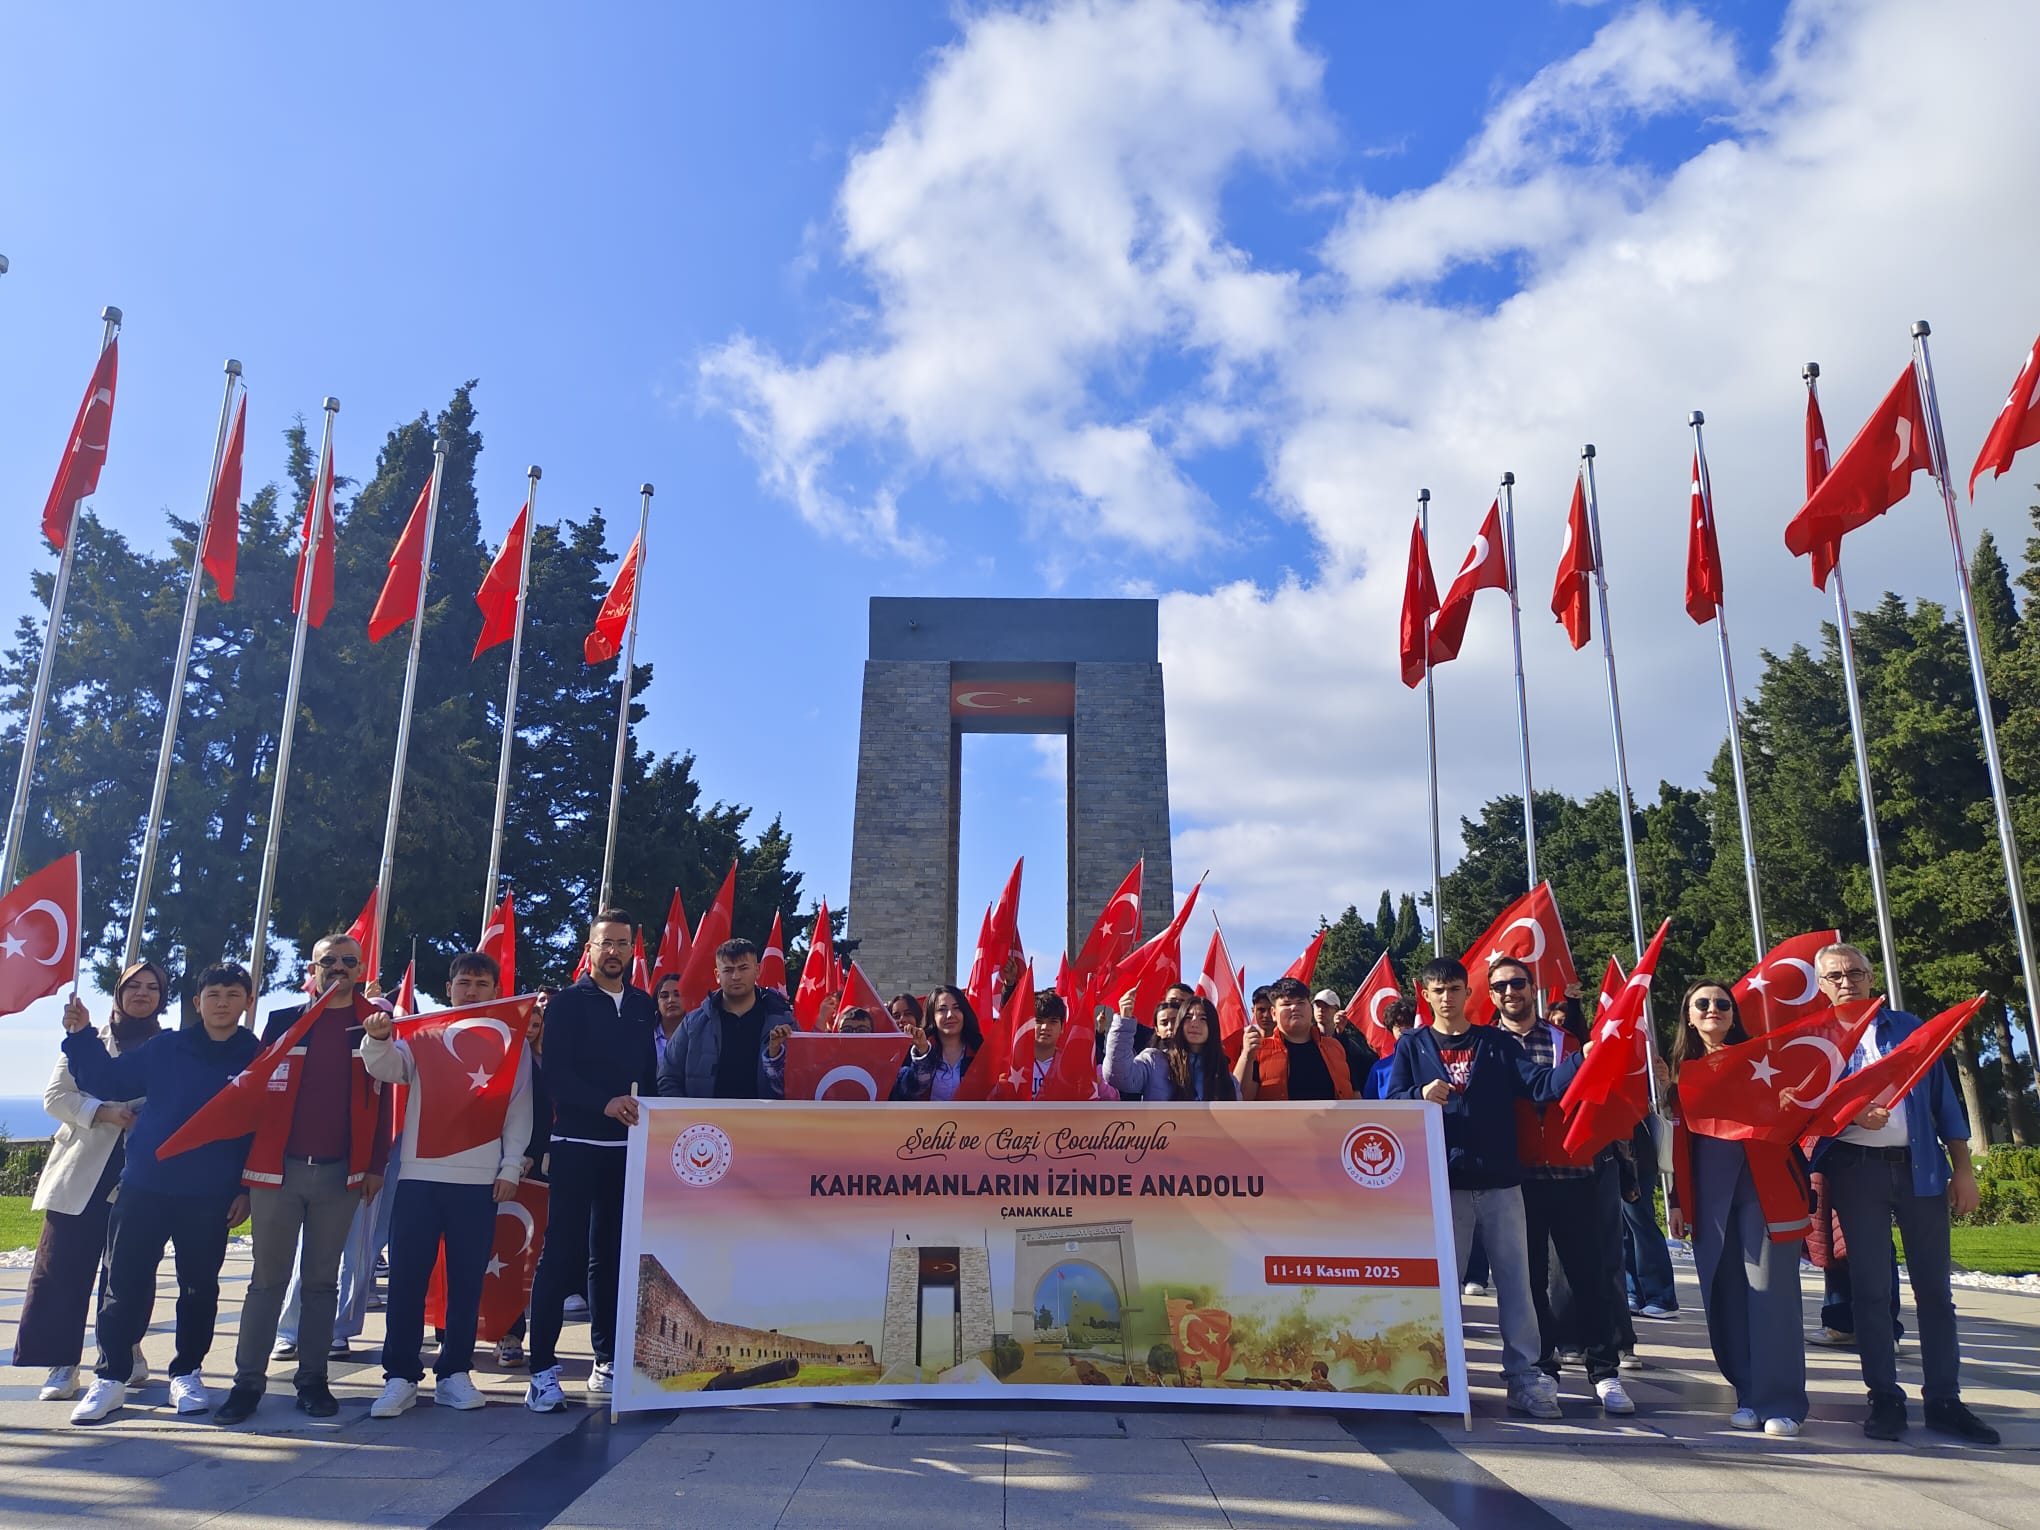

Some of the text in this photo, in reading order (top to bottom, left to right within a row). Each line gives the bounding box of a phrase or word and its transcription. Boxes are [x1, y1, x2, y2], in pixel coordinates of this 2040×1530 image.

[896, 1120, 1176, 1164] Şehit ve Gazi Çocuklarıyla
[810, 1168, 1264, 1197] KAHRAMANLARIN İZİNDE ANADOLU
[1000, 1206, 1073, 1220] ÇANAKKALE
[1272, 1263, 1400, 1279] 11-14 Kasım 2025
